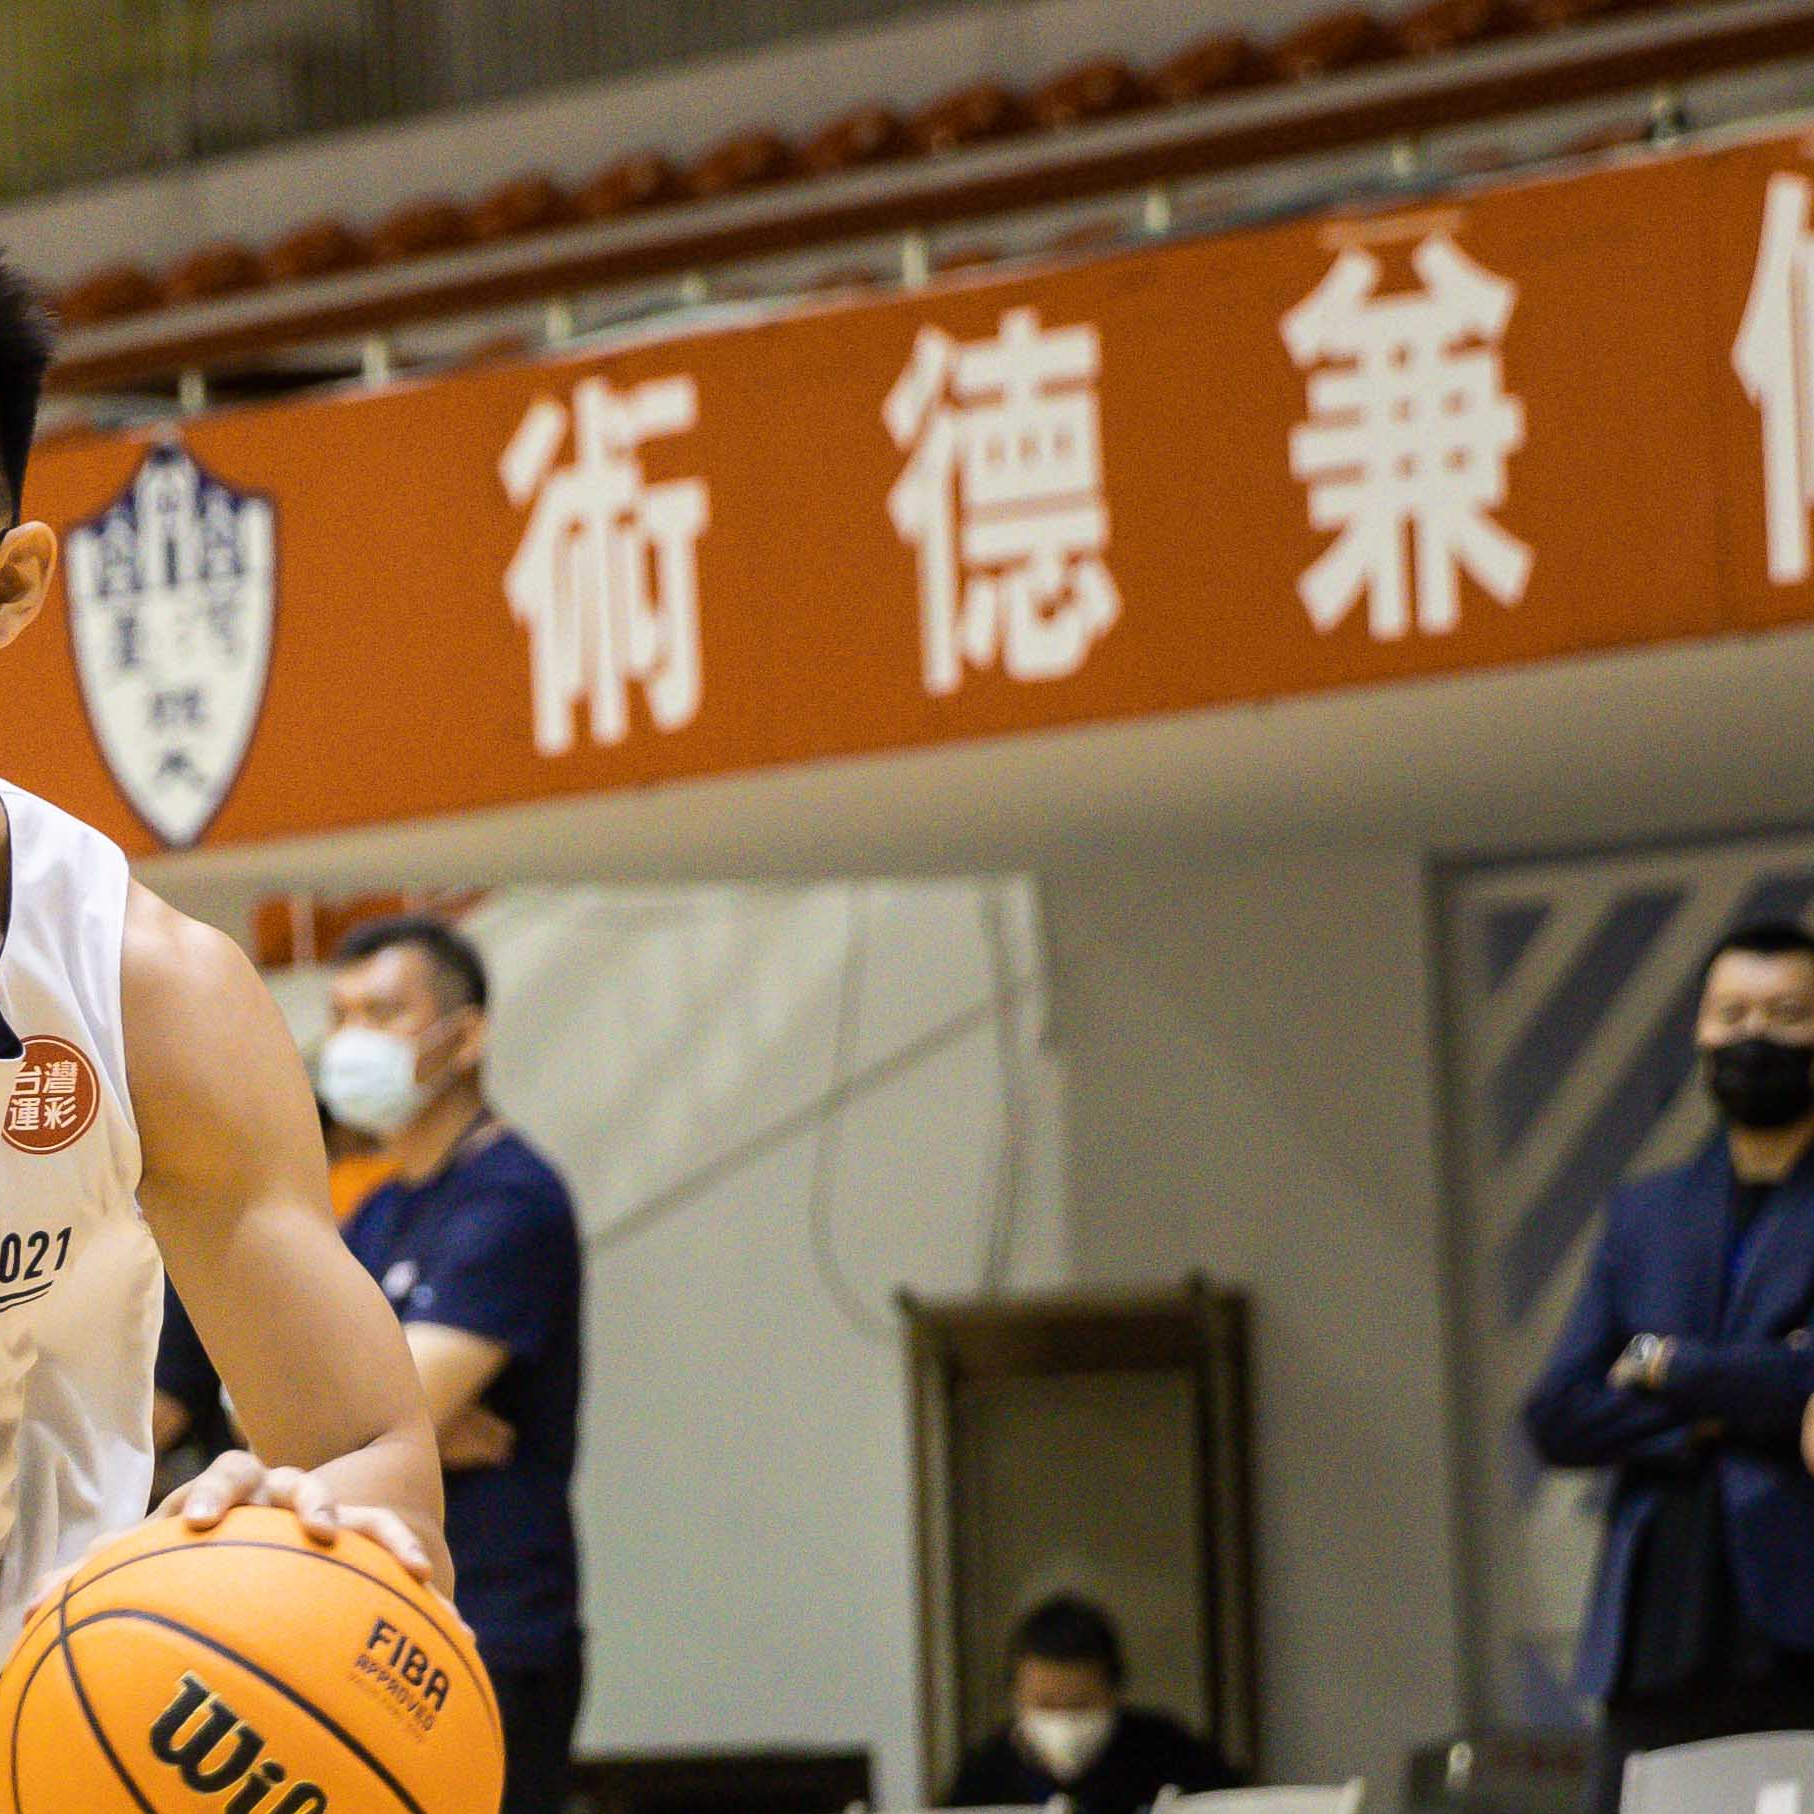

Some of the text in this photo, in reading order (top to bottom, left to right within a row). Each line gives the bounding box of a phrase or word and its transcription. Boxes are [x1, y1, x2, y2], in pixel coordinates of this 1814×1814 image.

[11, 1060, 78, 1094] 台灣
[7, 1095, 78, 1131] 運彩
[367, 1616, 450, 1712] FIBA
